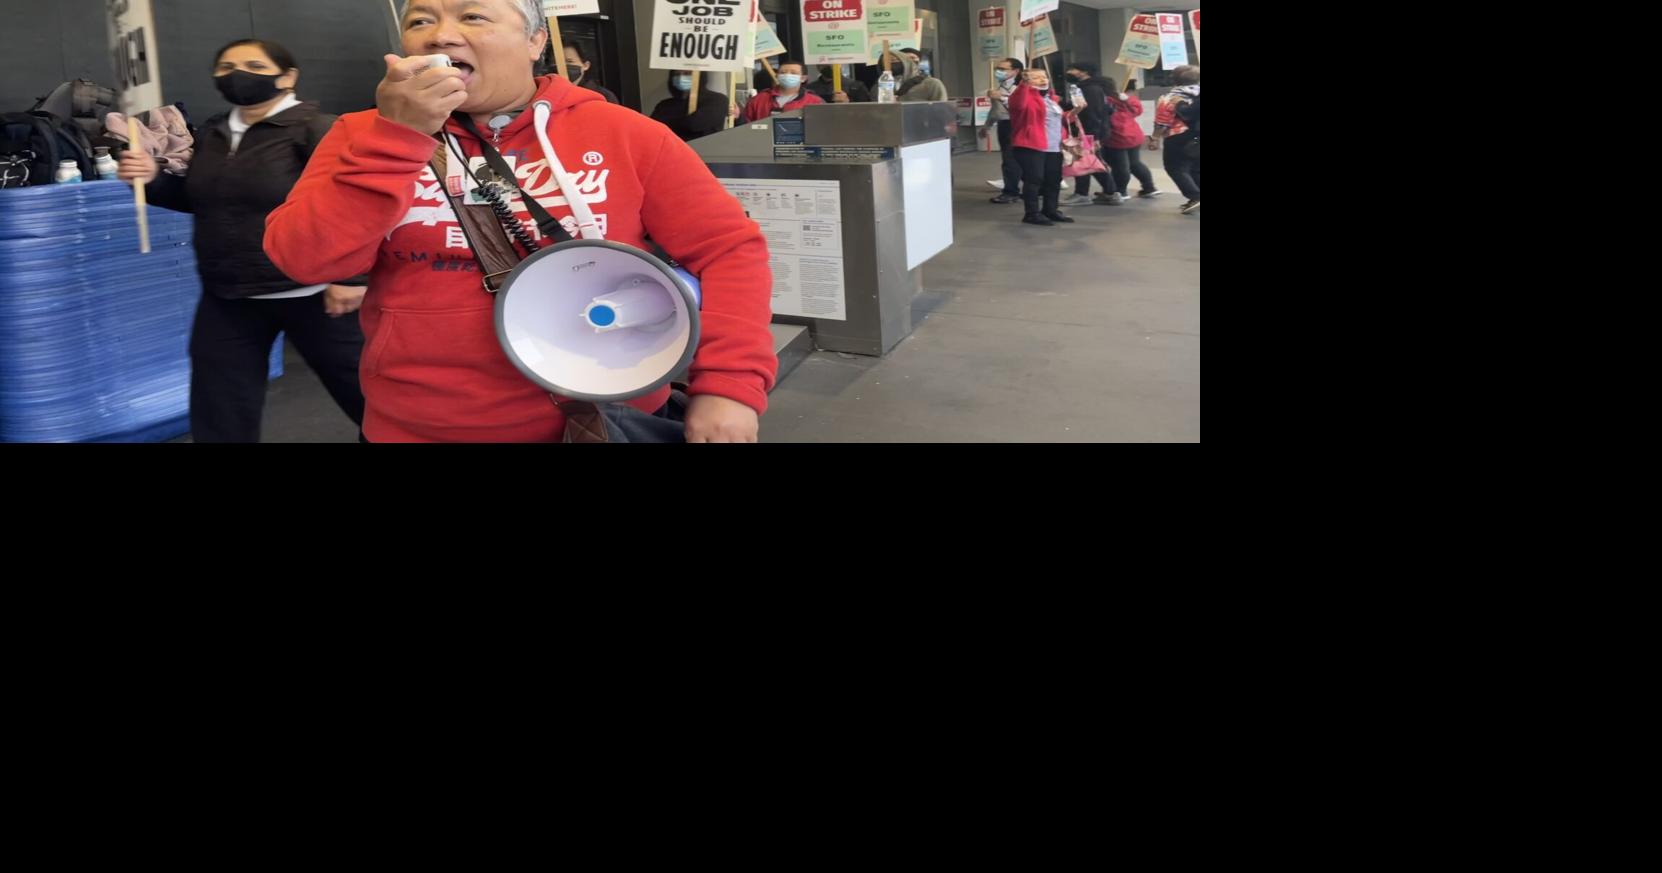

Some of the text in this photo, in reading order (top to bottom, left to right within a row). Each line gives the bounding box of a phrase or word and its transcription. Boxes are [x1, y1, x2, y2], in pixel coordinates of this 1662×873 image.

[822, 0, 843, 9] ON
[672, 5, 734, 17] JOB
[809, 9, 857, 19] STRIKE
[678, 17, 726, 25] SHOULD
[659, 31, 739, 60] ENOUGH
